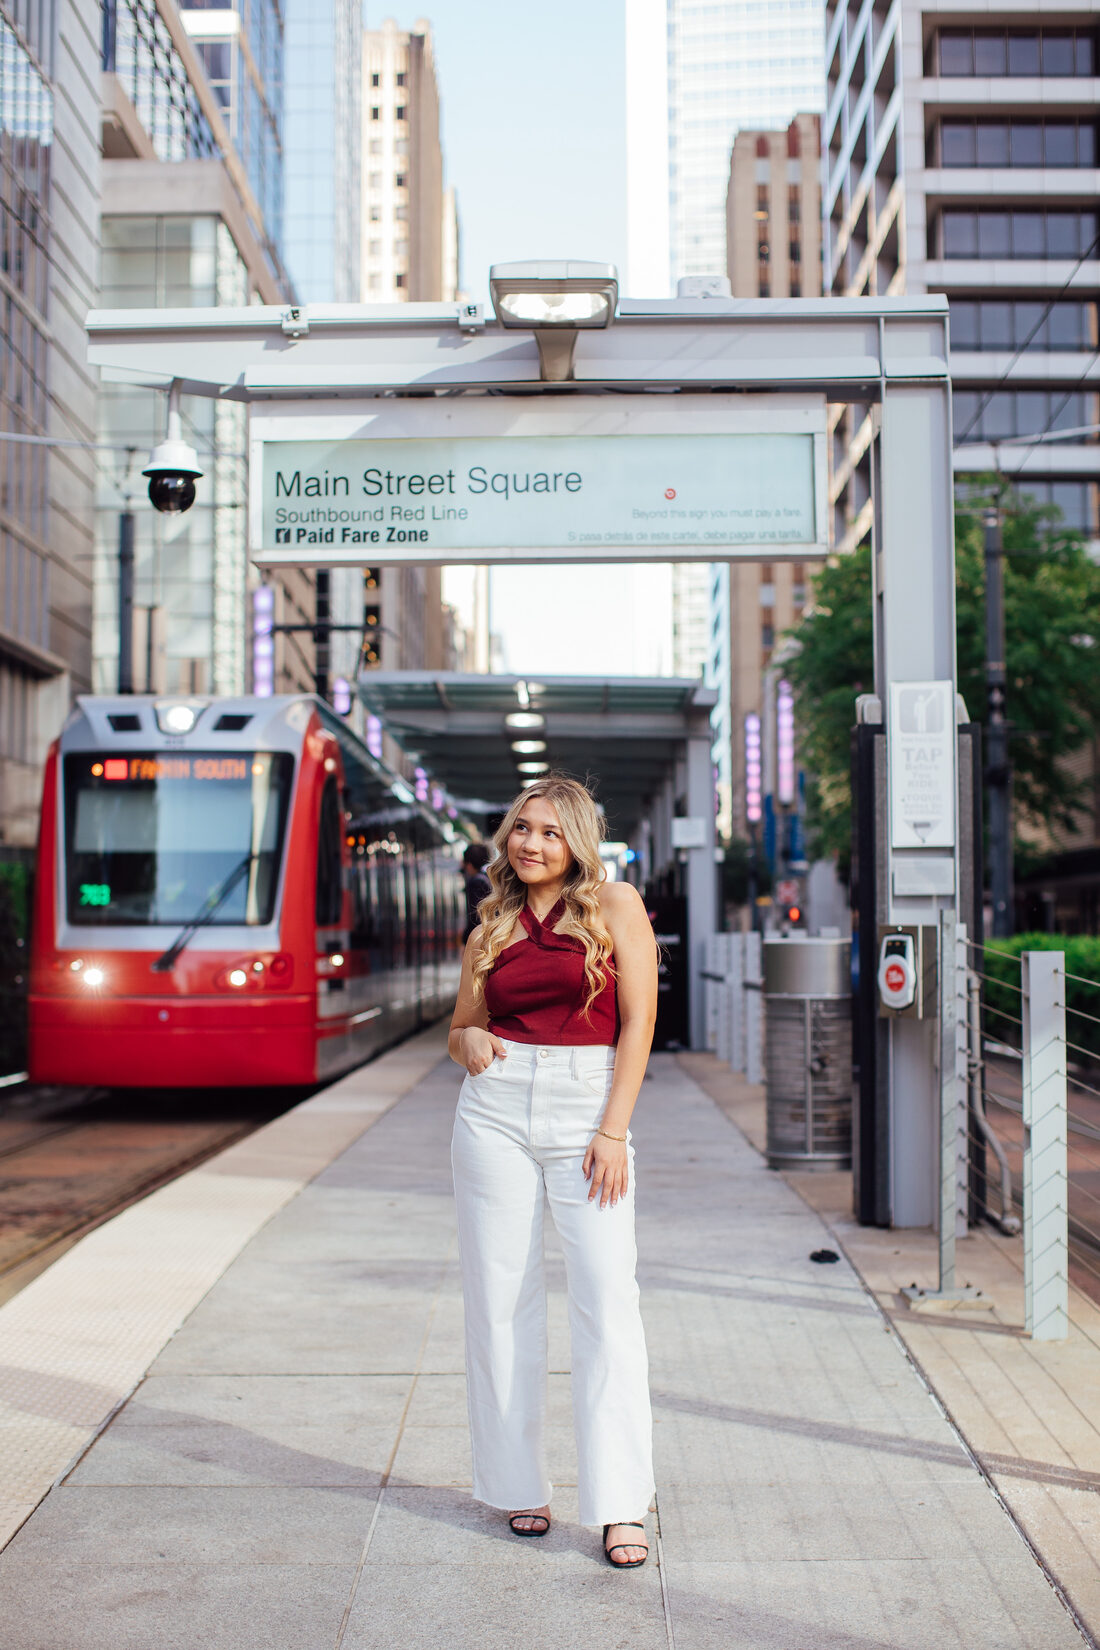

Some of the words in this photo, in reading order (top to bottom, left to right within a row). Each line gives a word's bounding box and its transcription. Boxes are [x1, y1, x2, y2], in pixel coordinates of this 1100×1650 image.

[275, 470, 350, 497] Main
[362, 468, 456, 496] Street
[467, 466, 583, 501] Square
[274, 507, 385, 524] Southbound
[390, 505, 425, 522] Red
[431, 505, 469, 521] Line
[631, 508, 668, 521] Beyond
[688, 508, 708, 520] sign
[709, 509, 729, 520] you
[729, 508, 753, 518] must
[755, 508, 773, 520] pay
[296, 527, 335, 544] Paid
[341, 527, 380, 544] Fare
[386, 526, 429, 543] Zone
[902, 748, 943, 763] TAP
[193, 759, 246, 780] SOUTH
